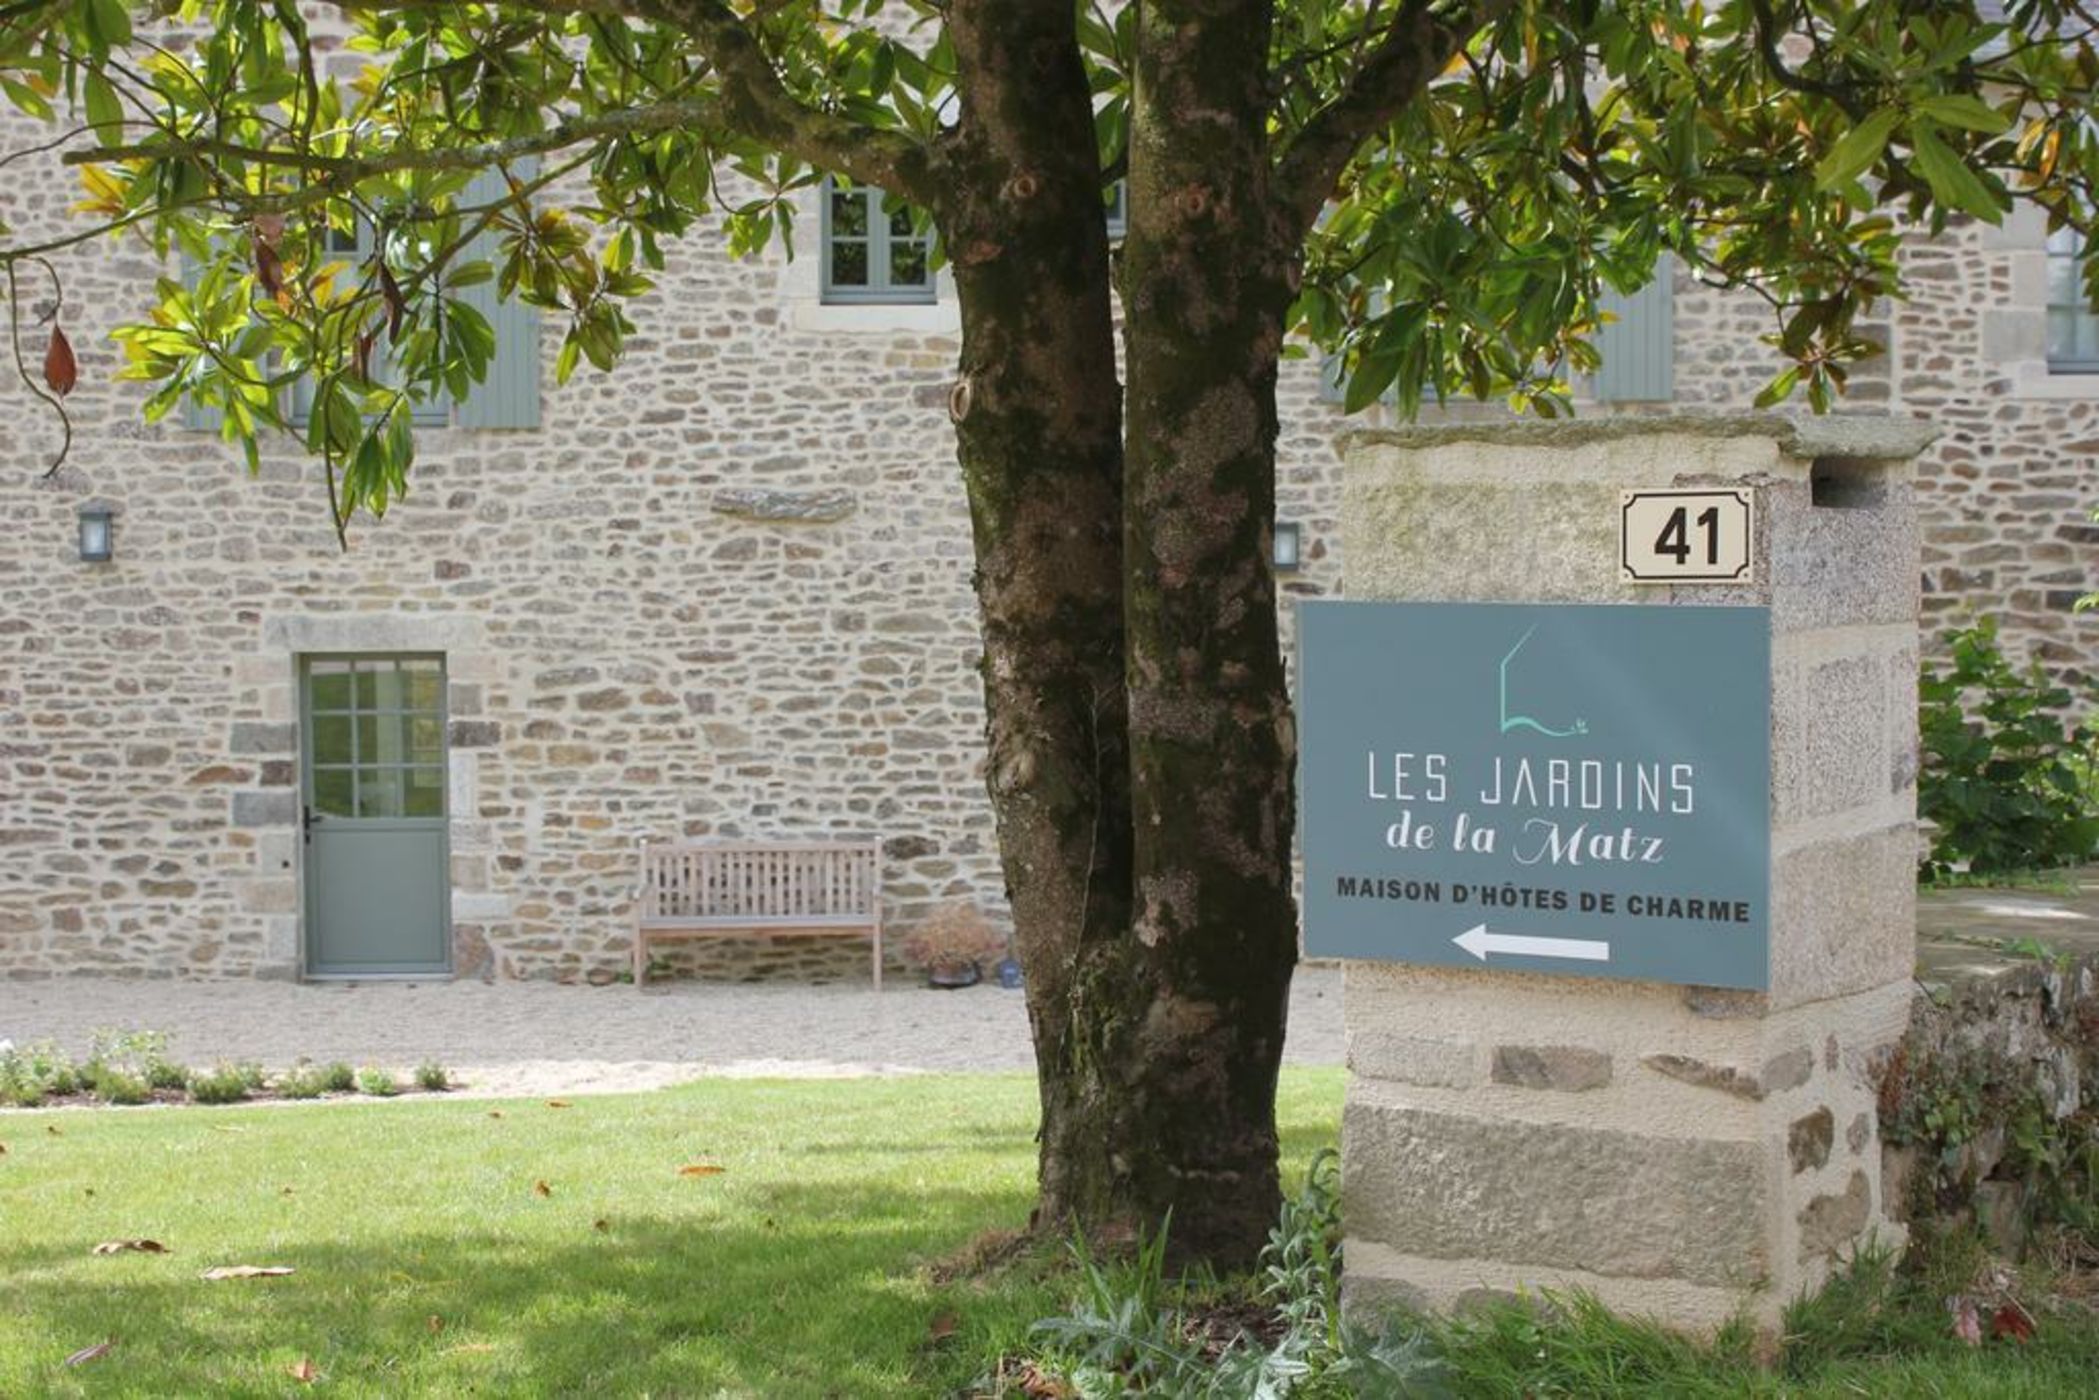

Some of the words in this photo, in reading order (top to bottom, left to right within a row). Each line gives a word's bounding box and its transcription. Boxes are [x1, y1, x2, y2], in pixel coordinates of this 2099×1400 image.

[1653, 506, 1720, 566] 41
[1367, 750, 1447, 802] LES
[1480, 756, 1694, 815] JARDINS
[1385, 810, 1435, 850] de
[1452, 812, 1496, 854] la
[1512, 817, 1665, 866] Matz
[1336, 875, 1441, 903] MAISON
[1452, 881, 1568, 911] D'HÔTES
[1579, 892, 1616, 915] DE
[1626, 894, 1751, 923] CHARME
